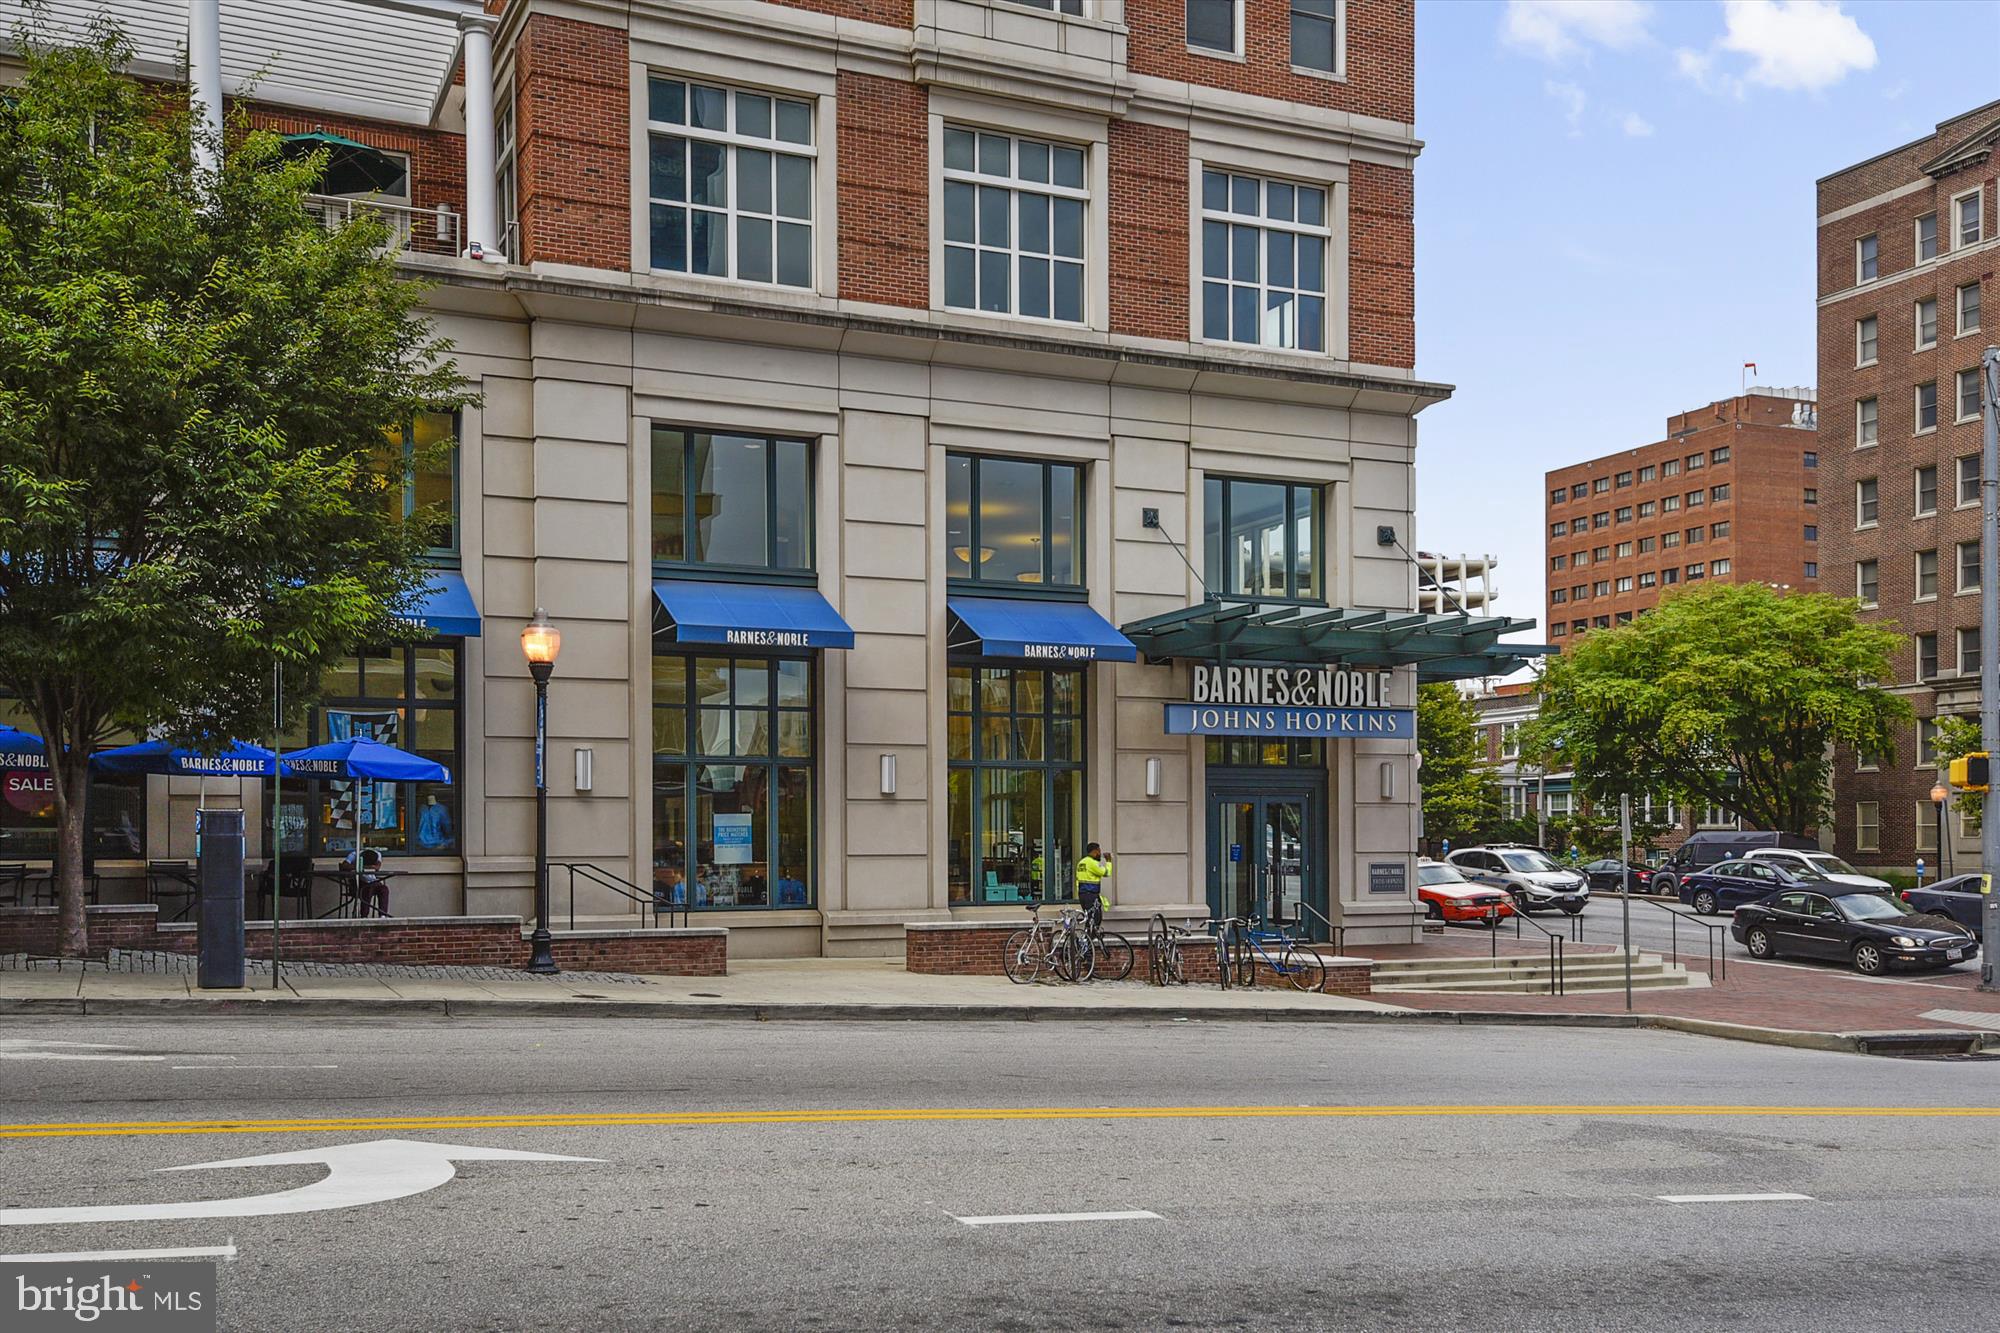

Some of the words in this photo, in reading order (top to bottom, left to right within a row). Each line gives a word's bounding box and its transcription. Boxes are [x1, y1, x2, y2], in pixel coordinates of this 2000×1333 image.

[727, 630, 808, 646] BARNES&NOBLE
[1193, 665, 1391, 708] BARNES&NOBLE
[1191, 709, 1275, 731] JOHNS
[1286, 711, 1397, 732] HOPKINS
[181, 757, 265, 772] BARNES&NOBLE
[9, 777, 54, 791] SALE
